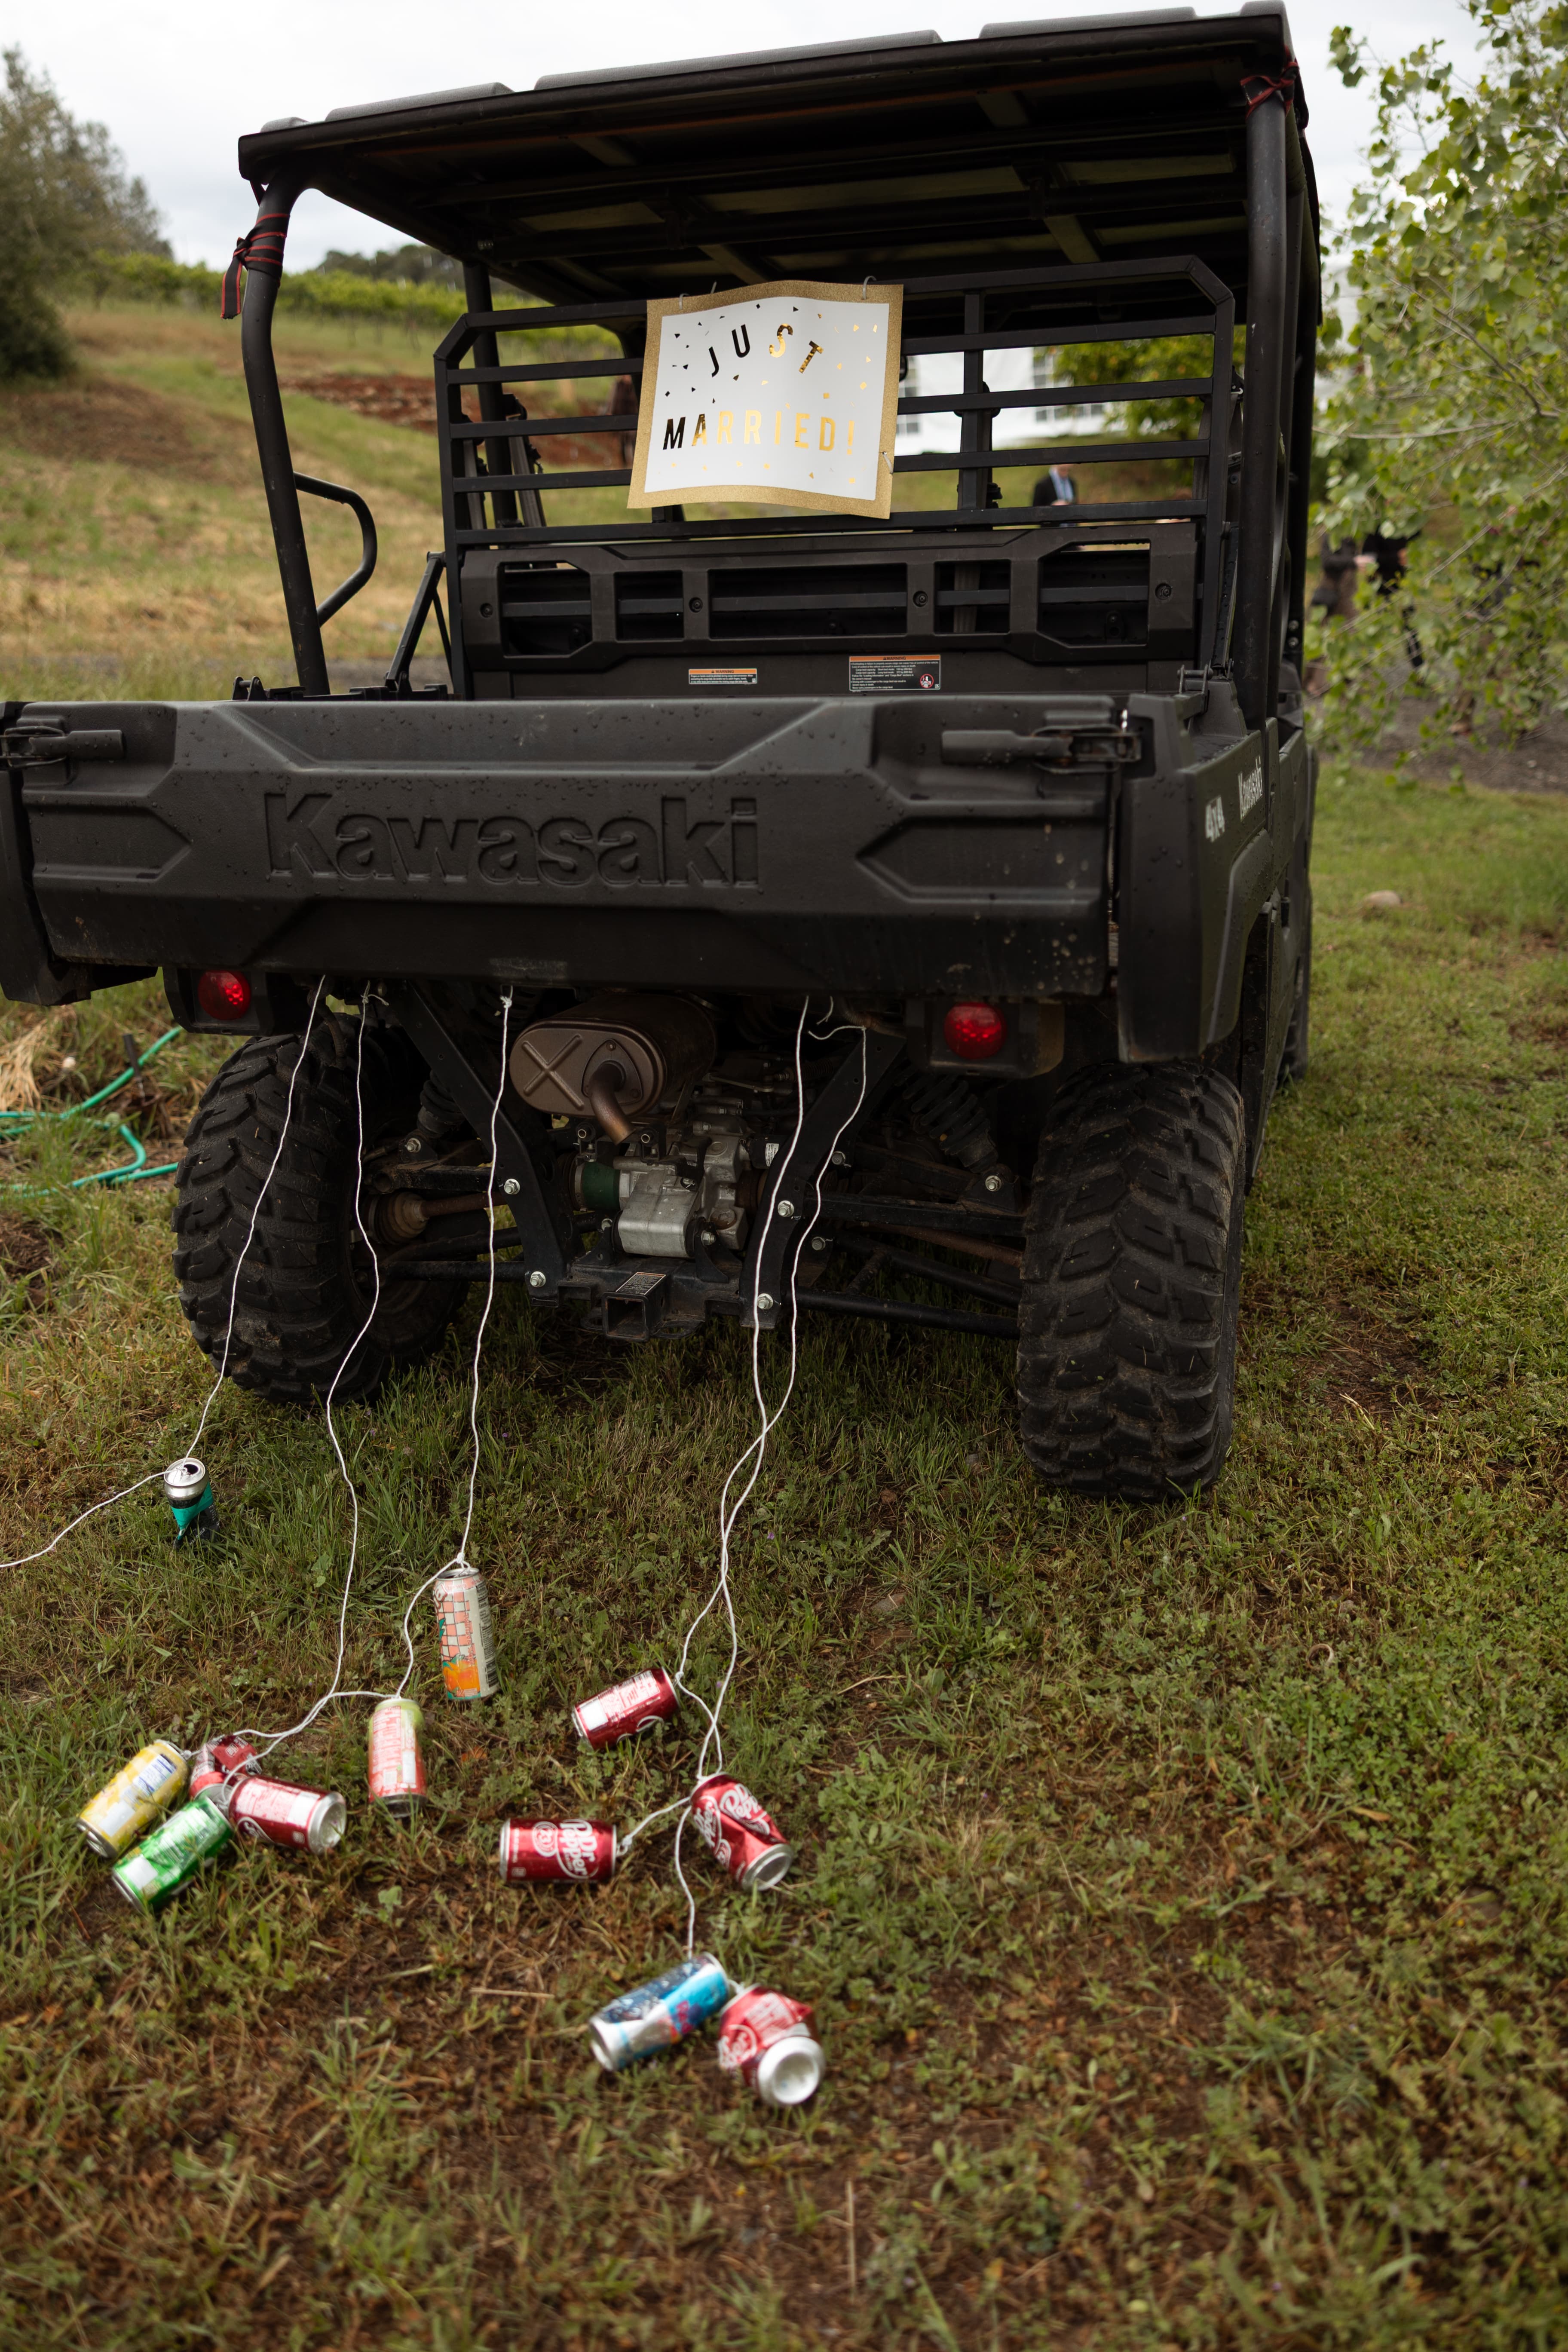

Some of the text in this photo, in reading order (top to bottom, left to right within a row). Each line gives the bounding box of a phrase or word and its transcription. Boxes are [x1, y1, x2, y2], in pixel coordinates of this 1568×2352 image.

[708, 323, 824, 377] JUST
[662, 410, 855, 455] MARRIED!
[1238, 756, 1263, 821] Kawasaki
[263, 793, 760, 888] Kawasaki
[558, 1822, 593, 1876] Pepper
[579, 1836, 597, 1862] Dr
